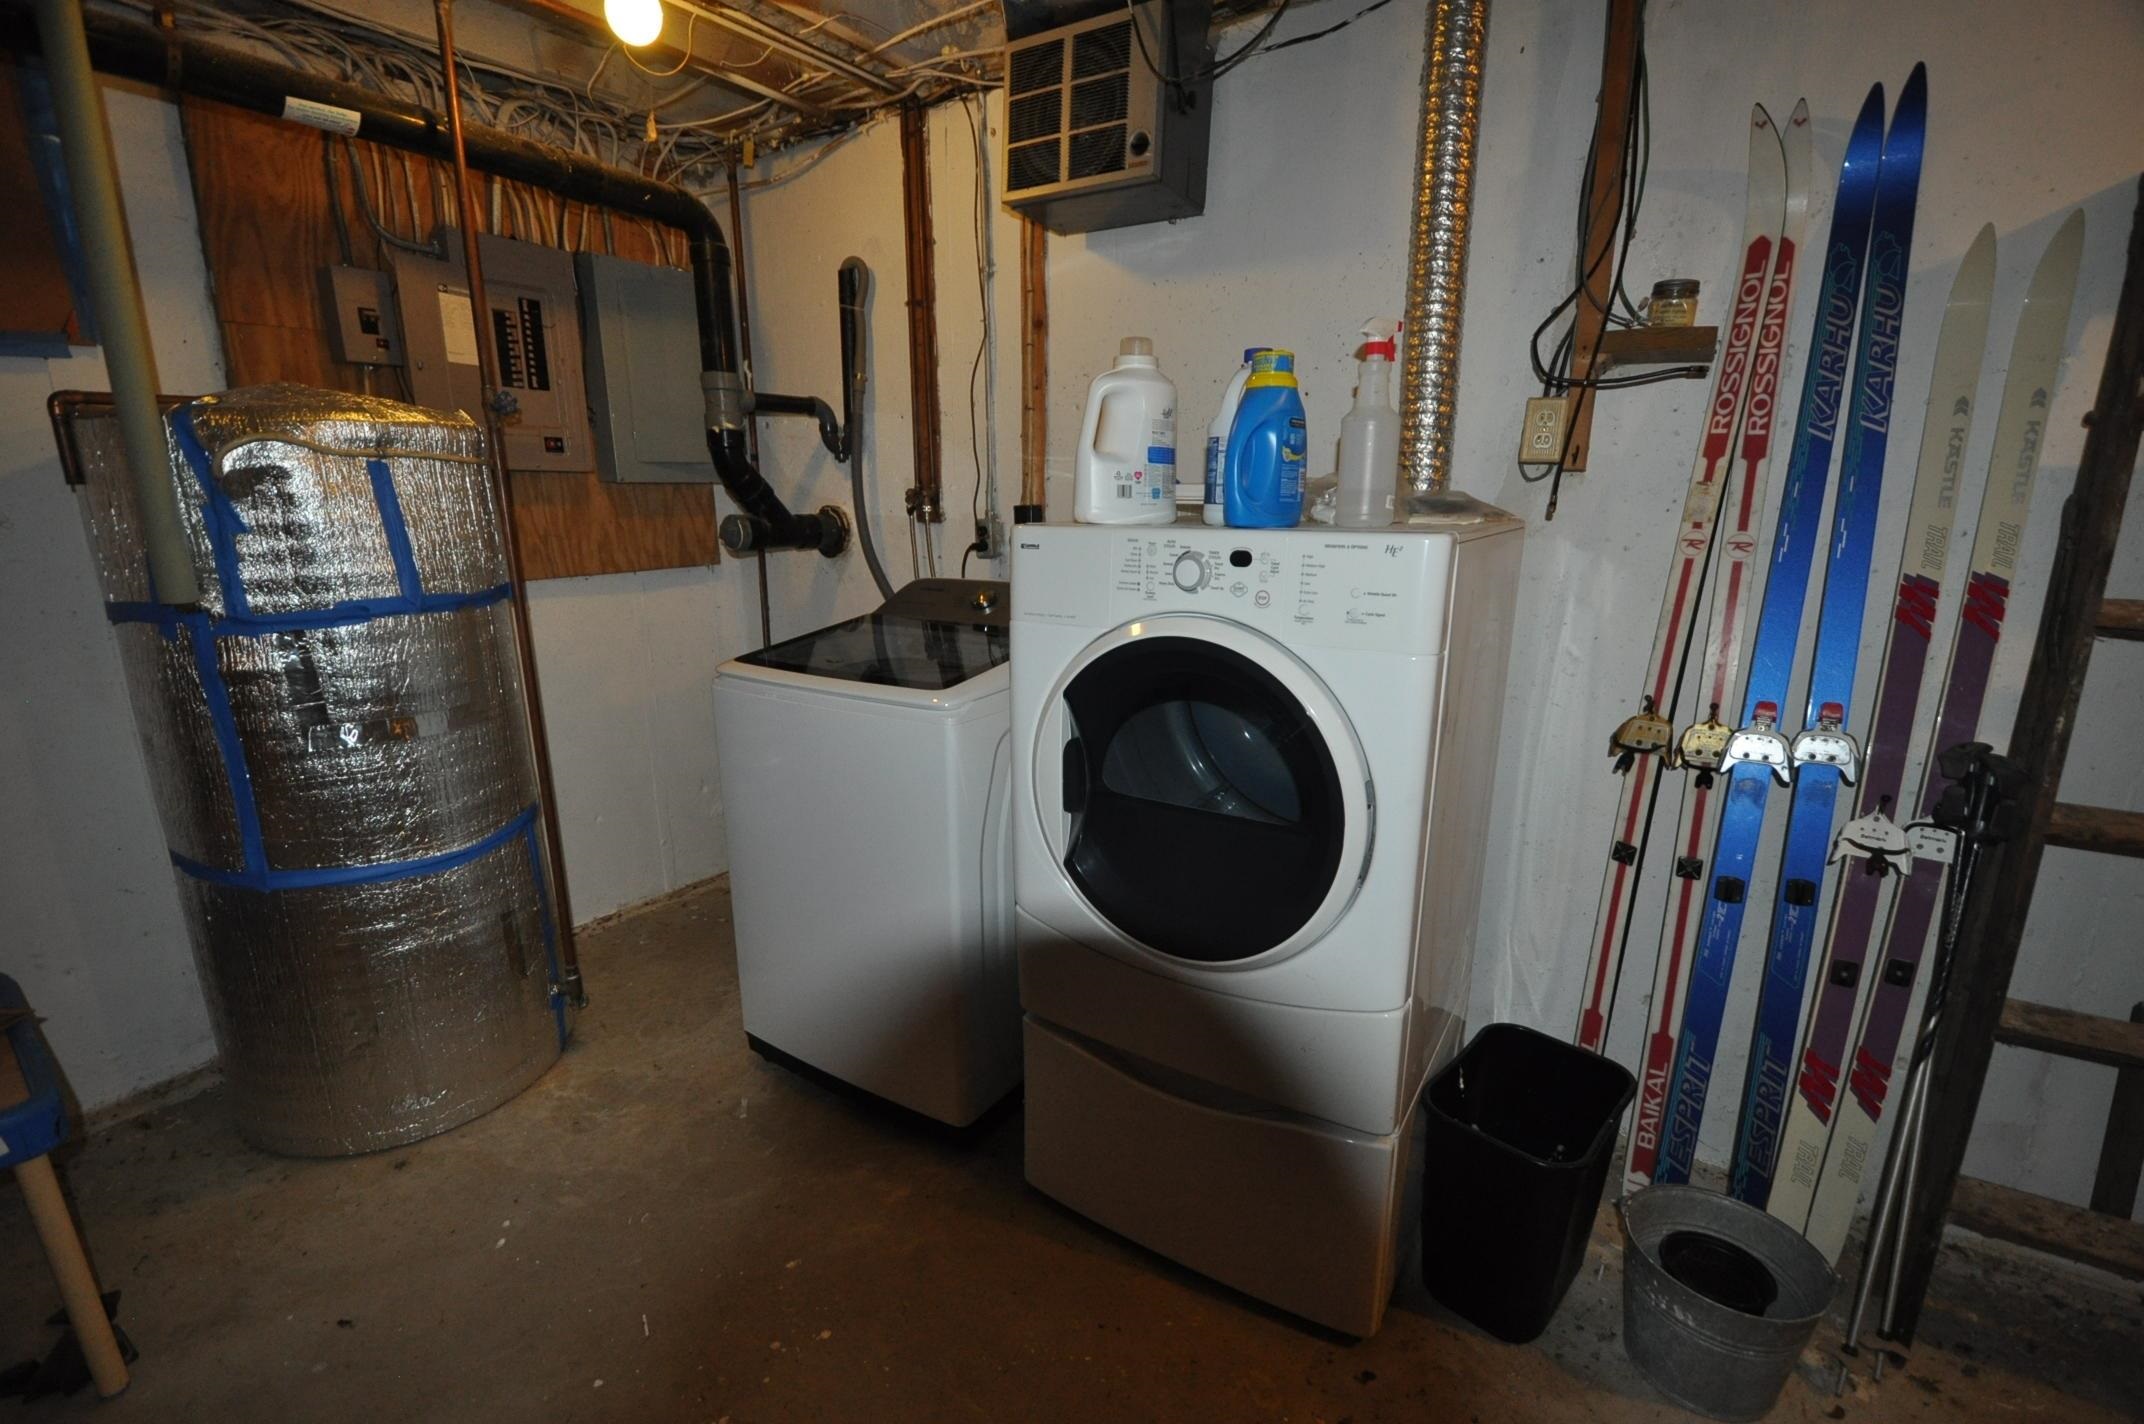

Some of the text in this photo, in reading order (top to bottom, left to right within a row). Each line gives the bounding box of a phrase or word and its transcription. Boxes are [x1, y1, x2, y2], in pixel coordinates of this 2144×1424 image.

[1711, 259, 1766, 434] ROSSIGNOL
[1747, 260, 1790, 435] ROSSIGNOL
[1807, 293, 1854, 441] KARHU
[1860, 282, 1902, 434] KARHU
[1921, 524, 1948, 571] TRAIL
[1991, 521, 2020, 570] TRAIL
[1637, 1062, 1668, 1150] BAIKAL
[1669, 1055, 1711, 1176] ESPRIT
[1748, 1056, 1788, 1178] ESPRIT
